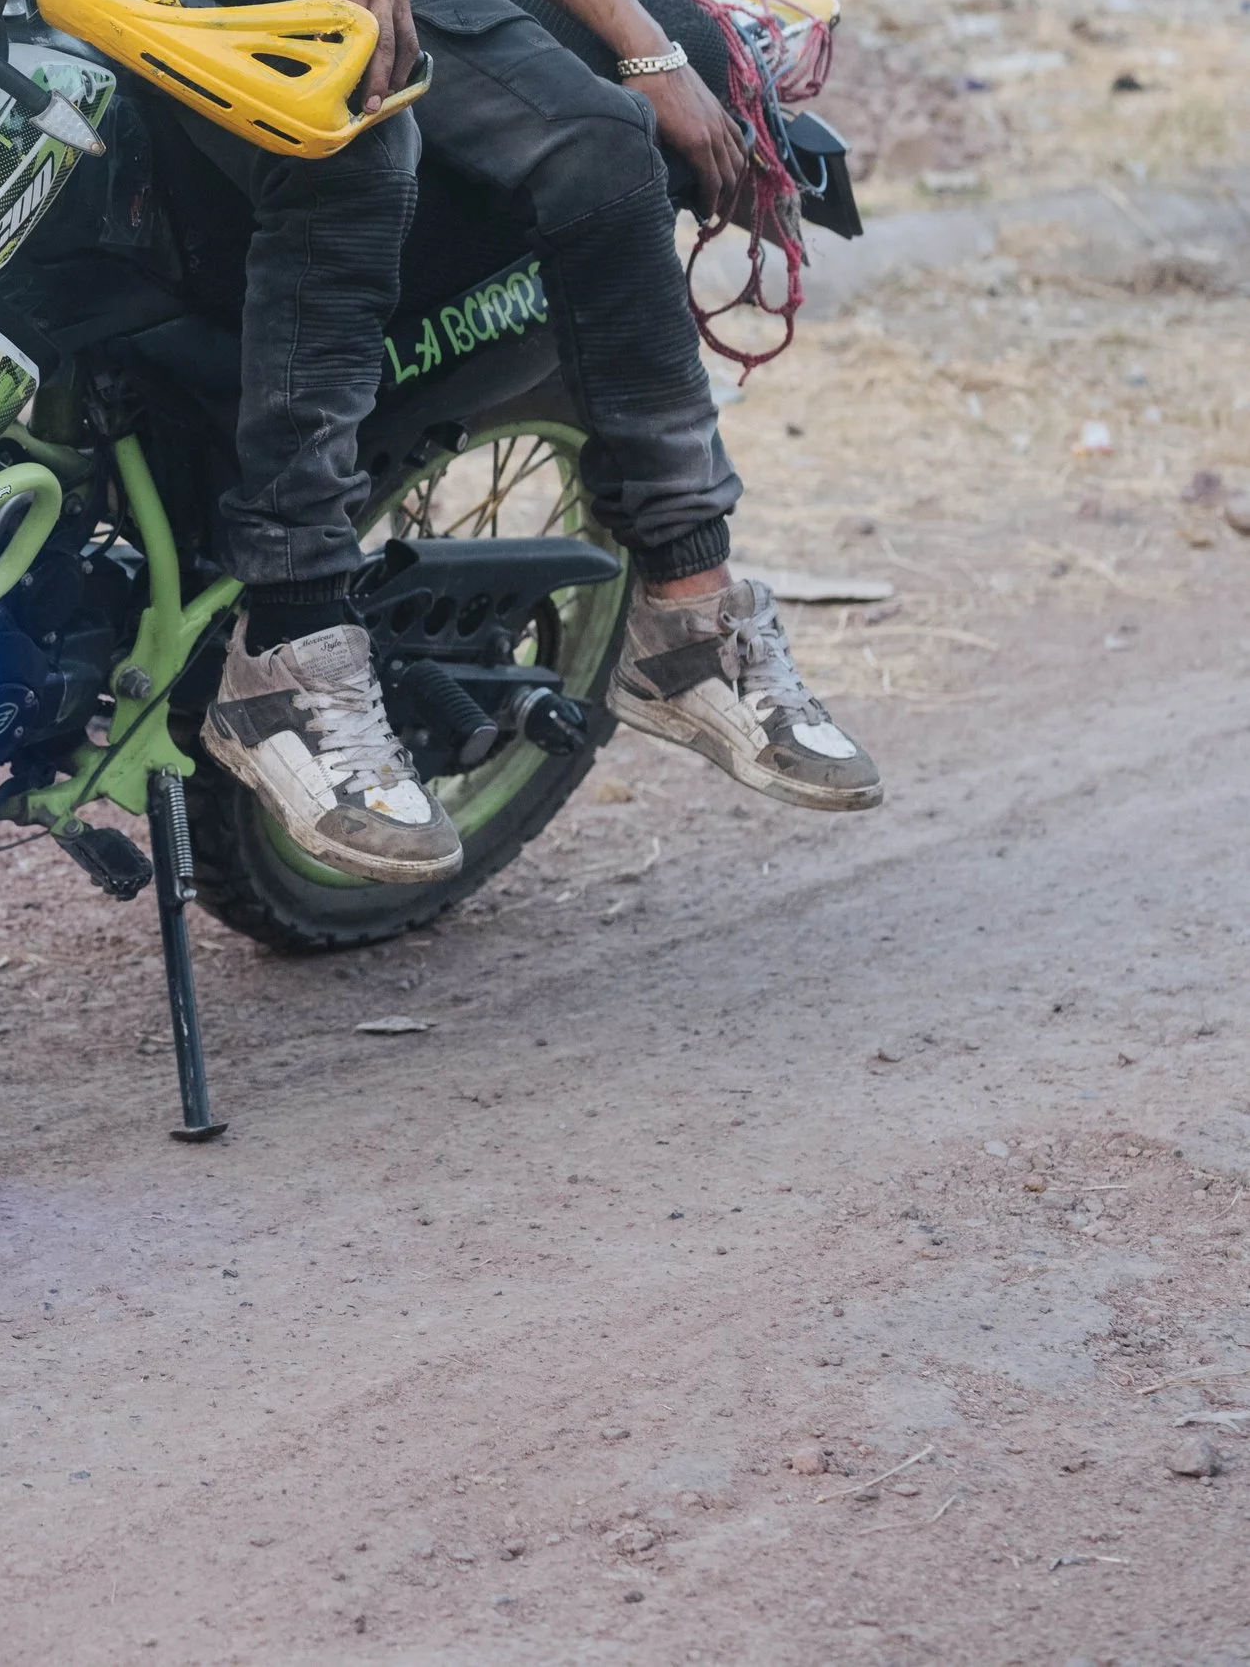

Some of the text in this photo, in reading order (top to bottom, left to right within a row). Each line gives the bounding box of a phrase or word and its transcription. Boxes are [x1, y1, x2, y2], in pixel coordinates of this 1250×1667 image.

[384, 261, 549, 384] LA BURR
[298, 633, 335, 650] Mexican
[320, 638, 342, 652] Style
